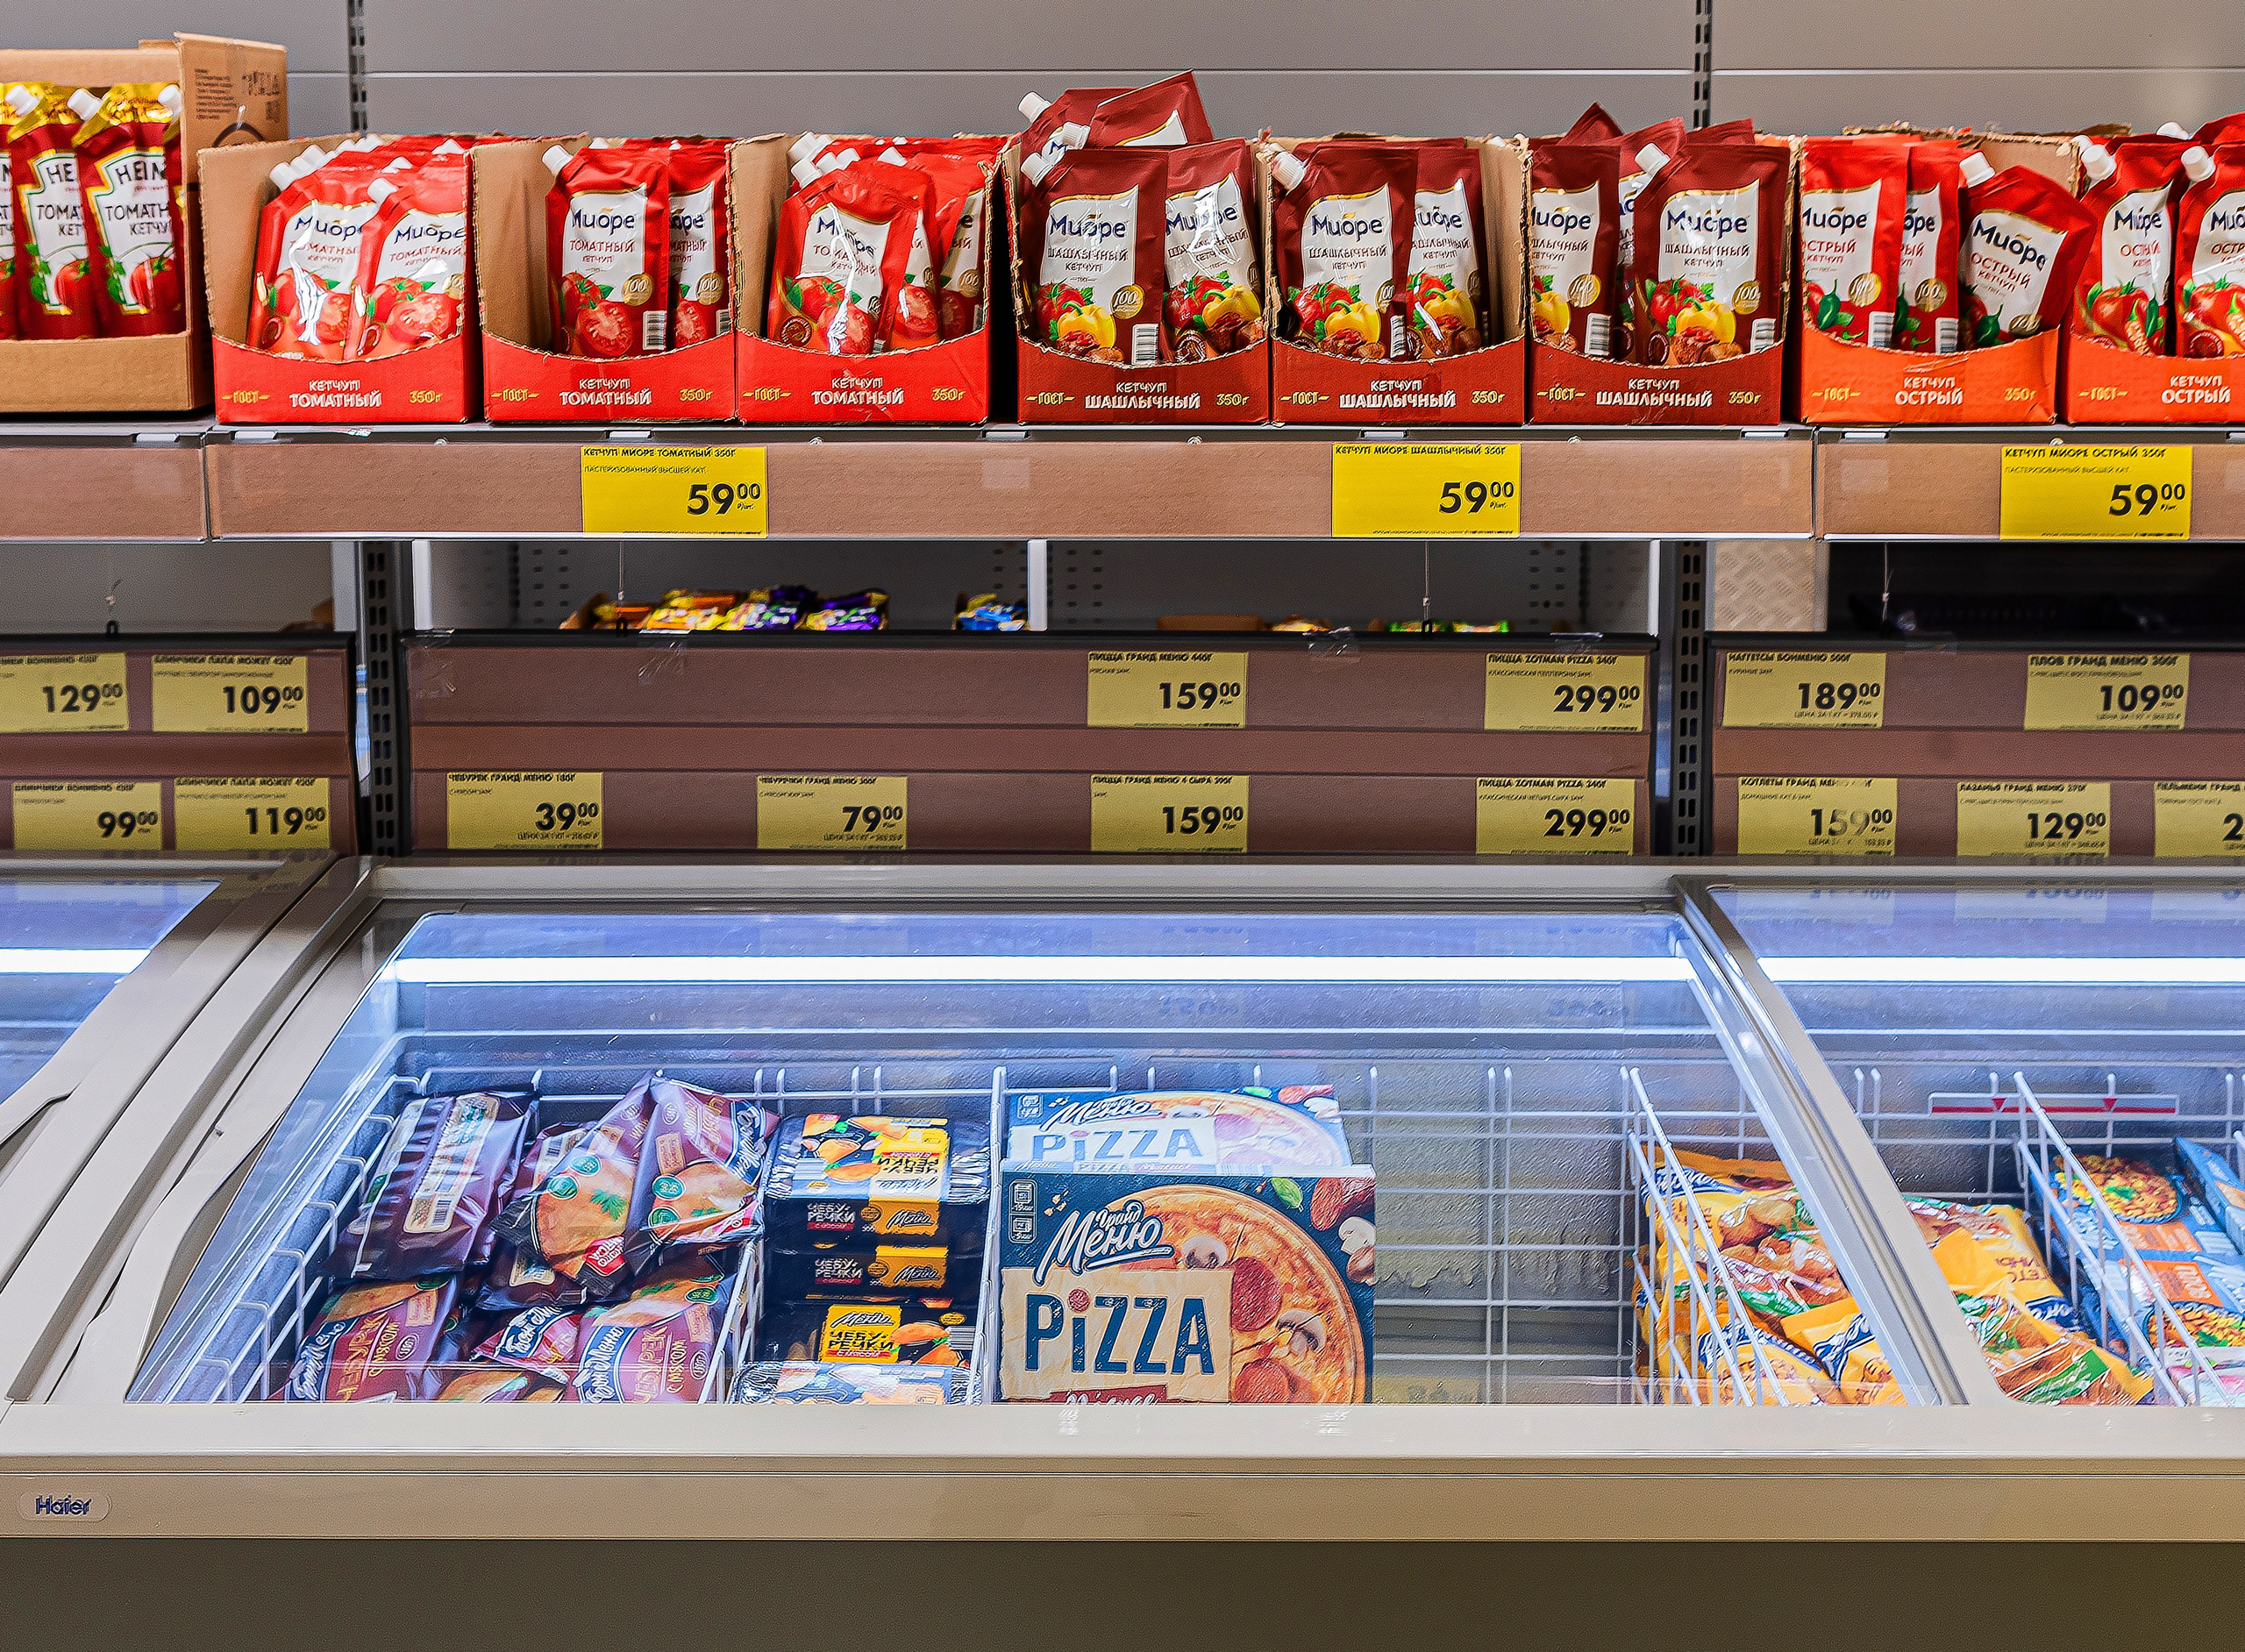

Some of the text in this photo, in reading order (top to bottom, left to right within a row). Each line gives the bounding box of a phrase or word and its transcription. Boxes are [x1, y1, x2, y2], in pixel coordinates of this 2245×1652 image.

[1050, 213, 1127, 242] Миоре
[1312, 215, 1383, 242] Миоре
[1667, 210, 1748, 239] Миоре
[570, 239, 637, 253] ТОМАТНЫЙ
[1665, 244, 1750, 257] ШАШЛЫЧНЫЙ
[1974, 218, 2048, 271] Миоре
[389, 245, 462, 262] ТОМАТНЫЙ
[582, 254, 614, 263] КЕТЧУП
[1048, 247, 1130, 261] ШАШЛЫЧНЫЙ
[1309, 245, 1388, 259] ШАШЛЫЧНЫЙ
[1422, 251, 1457, 260] КЕТЧУП
[1807, 253, 1844, 263] КЕТЧУП
[1065, 262, 1104, 272] КЕТЧУП
[1332, 260, 1367, 269] КЕТЧУП
[1684, 258, 1725, 267] КЕТЧУП
[1971, 252, 2031, 289] ОСТРЫЙ
[1978, 268, 2017, 292] КЕТЧУП
[309, 380, 360, 391] КЕТЧУП
[579, 378, 631, 389] КЕТЧУП
[831, 377, 884, 389] КЕТЧУП
[1115, 381, 1167, 393] КЕТЧУП
[1370, 380, 1422, 391] КЕТЧУП
[1629, 378, 1680, 390] КЕТЧУП
[1904, 377, 1956, 388] КЕТЧУП
[2170, 375, 2222, 388] КЕТЧУП
[289, 390, 382, 407] ТОМАТНЫЙ
[559, 388, 652, 406] ТОМАТНЫЙ
[811, 388, 905, 405] ТОМАТНЫЙ
[1085, 392, 1201, 409] ШАШЛЫЧНЫЙ
[1338, 390, 1457, 409] ШАШЛЫЧНЫЙ
[1596, 390, 1713, 407] ШАШЛЫЧНЫЙ
[1895, 388, 1963, 405] ОСТРЫЙ
[2162, 386, 2230, 403] ОСТРЫЙ
[584, 446, 736, 457] КЕТЧУП МИОРЕ ТОМАТНЫЙ 350Г
[1336, 445, 1371, 454] КЕТЧУП
[1374, 445, 1408, 454] МИОРЕ
[1411, 444, 1482, 455] ШАШЛЫЧНЫЙ
[2005, 448, 2046, 458] КЕТЧУП
[2049, 448, 2089, 458] МИОРЕ
[2092, 446, 2138, 458] ОСТРЫЙ
[1033, 1208, 1166, 1285] Меню
[35, 1494, 92, 1515] Haier
